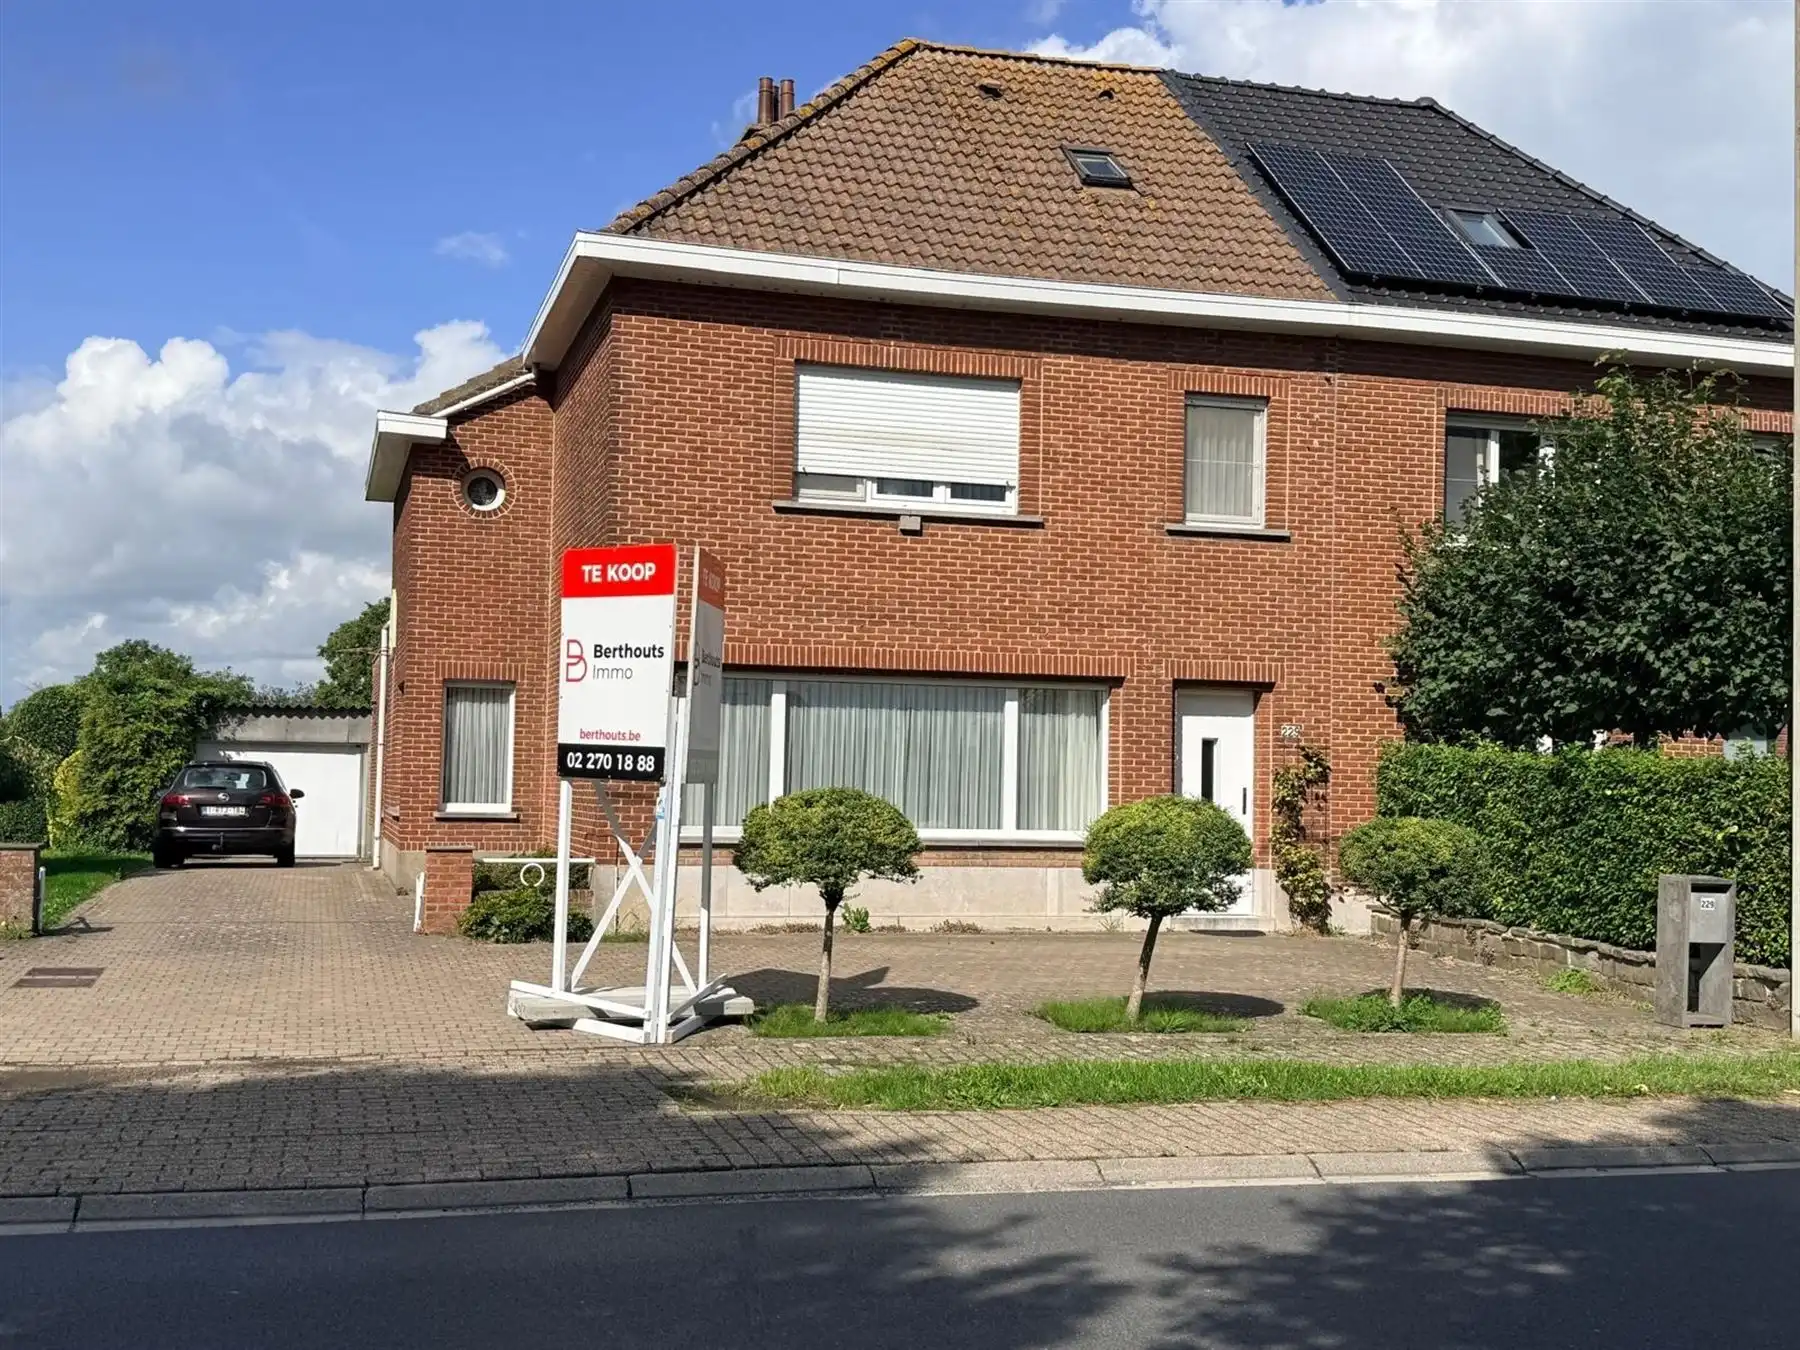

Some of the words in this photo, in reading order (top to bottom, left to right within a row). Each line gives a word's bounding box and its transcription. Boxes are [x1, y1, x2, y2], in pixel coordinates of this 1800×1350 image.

[581, 563, 602, 583] TE
[607, 561, 656, 582] KOOP
[593, 643, 665, 659] Berthouts
[592, 664, 633, 680] Immo
[579, 728, 641, 741] berthouts.be
[566, 751, 583, 768] 02
[586, 752, 613, 770] 270
[616, 753, 634, 771] 18
[637, 755, 655, 772] 88
